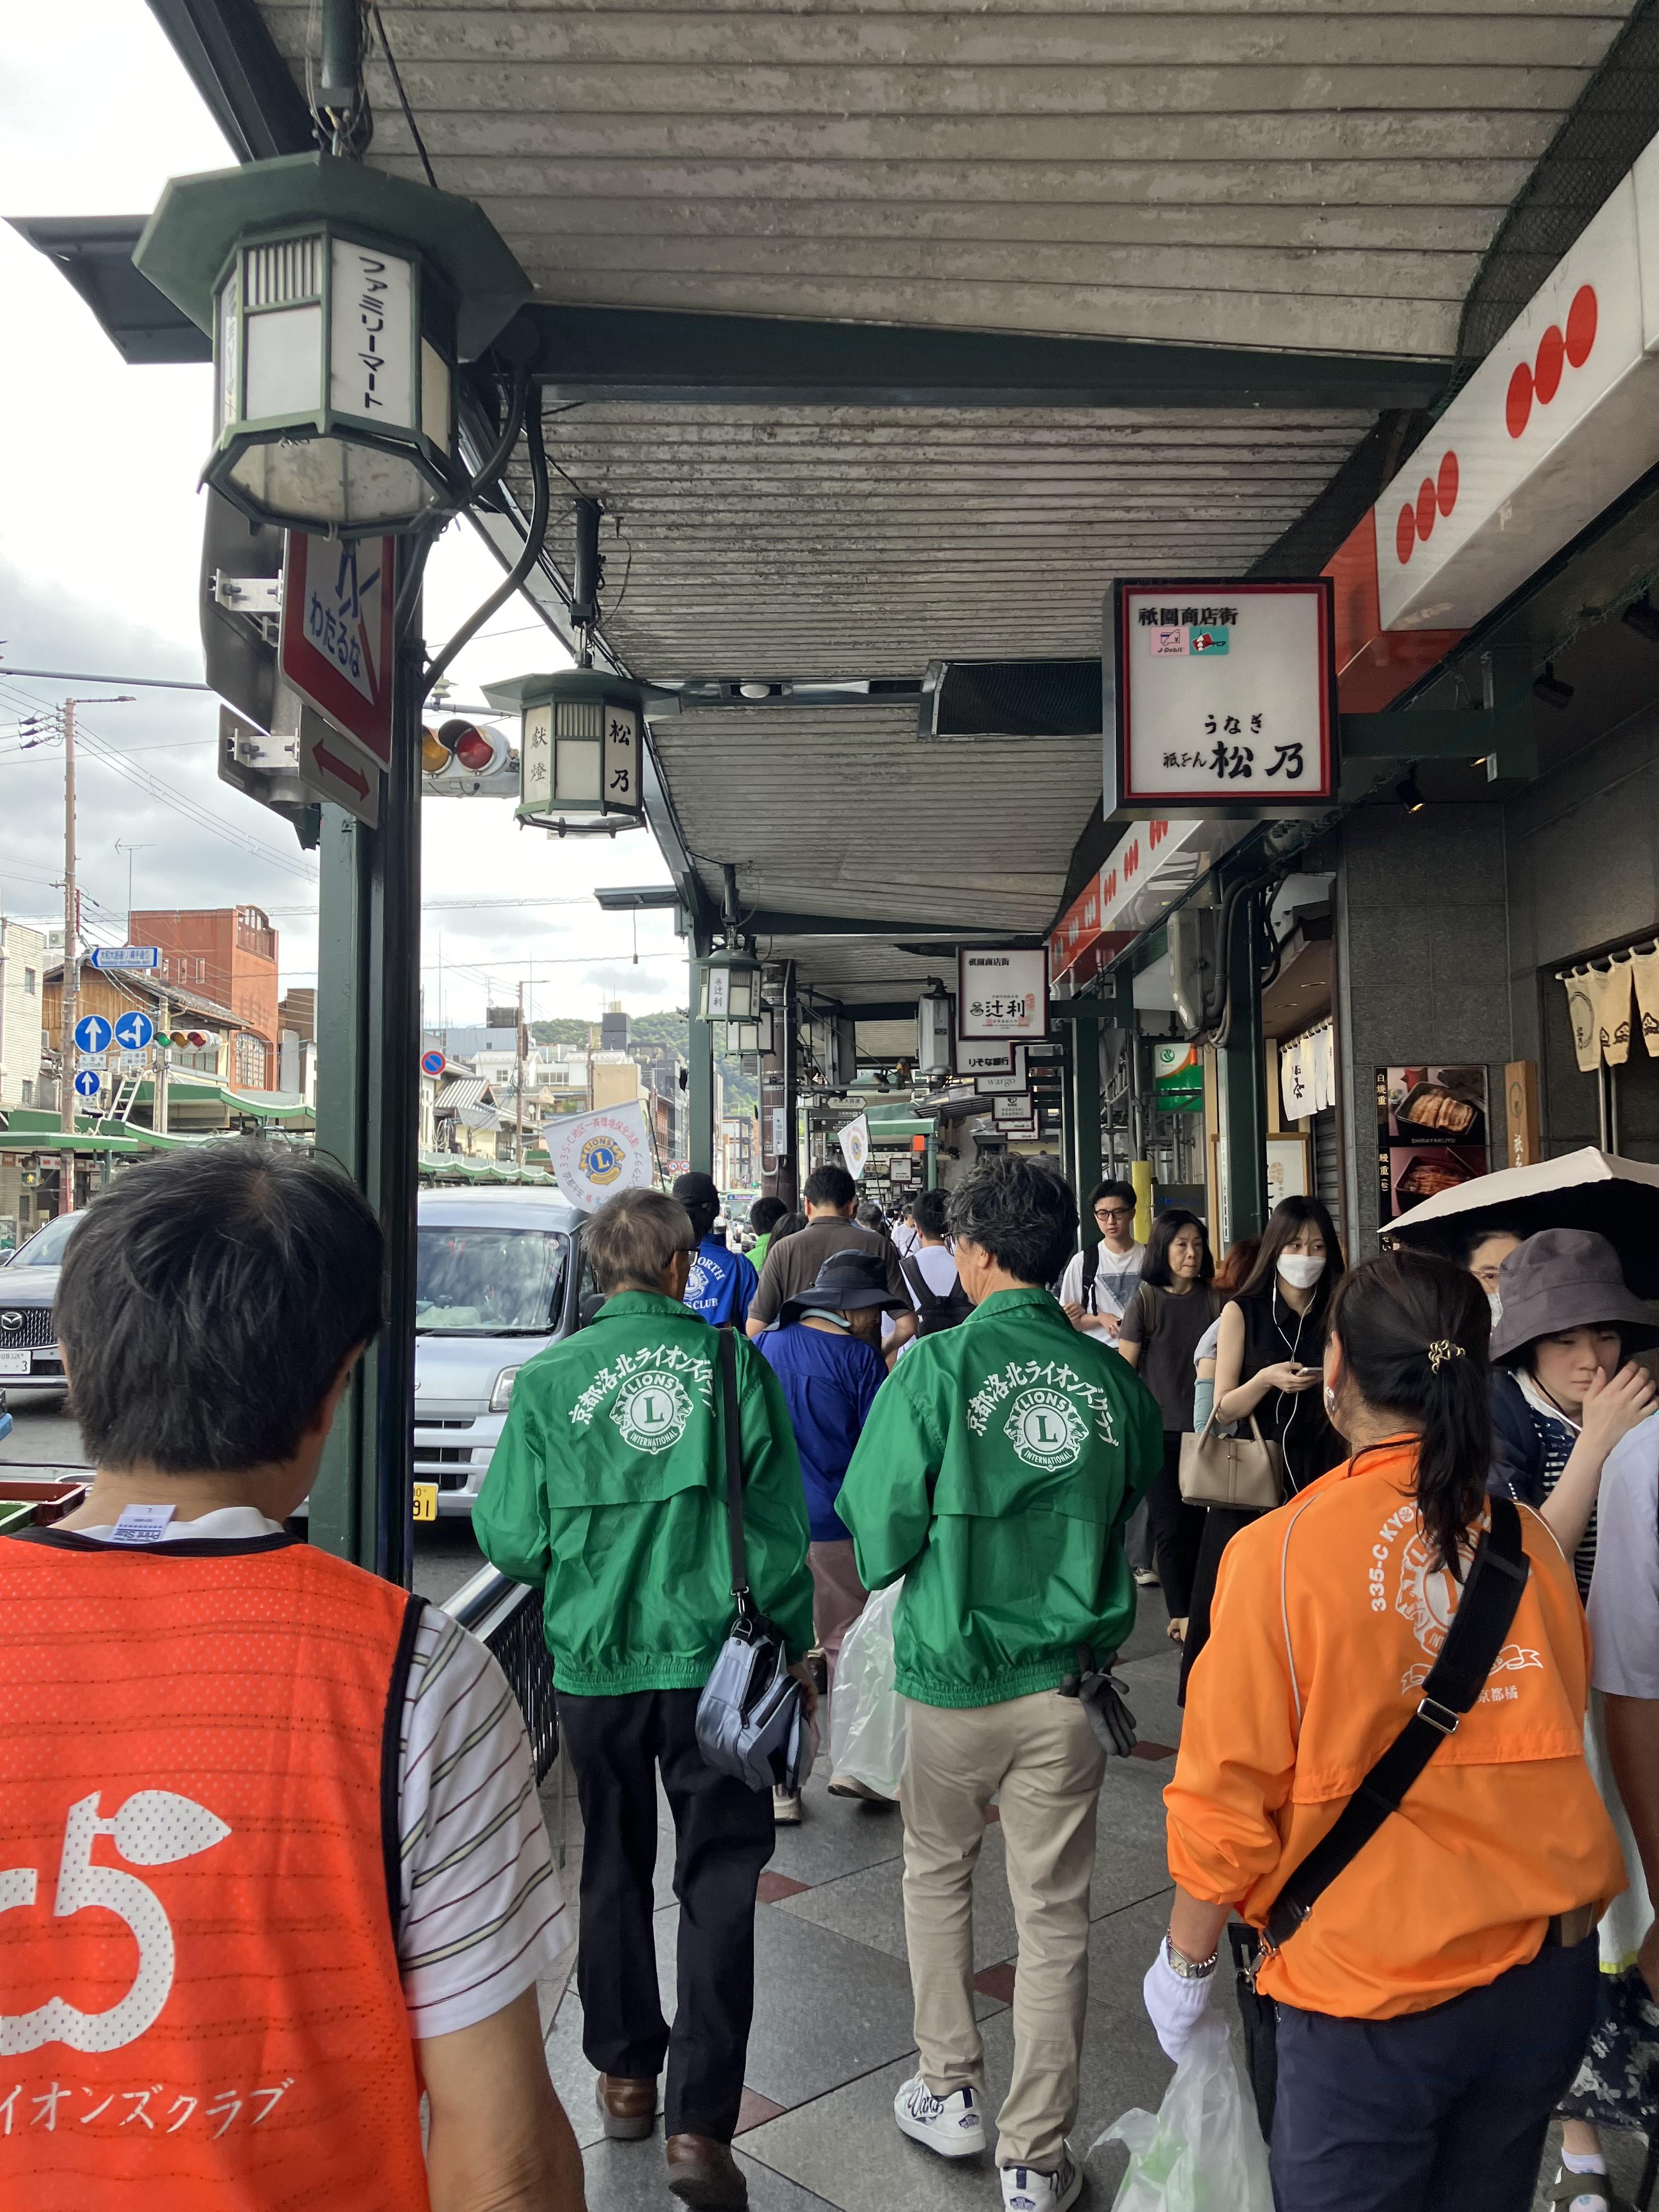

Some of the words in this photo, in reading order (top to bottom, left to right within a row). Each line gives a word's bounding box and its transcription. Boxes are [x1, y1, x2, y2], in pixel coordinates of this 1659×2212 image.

[358, 256, 387, 409] ファミリーマート
[309, 590, 362, 678] わたるな
[1204, 713, 1262, 734] うなぎ
[610, 719, 631, 793] 松乃
[1209, 741, 1304, 779] 松乃
[985, 1000, 1025, 1018] 辻利
[969, 1058, 1009, 1066] りそな銀行
[988, 1078, 1015, 1087] wargo
[1376, 1073, 1387, 1105] 白焼重
[584, 1138, 612, 1153] LIONS
[595, 1152, 610, 1169] L
[697, 1256, 725, 1281] ORTH
[693, 1297, 718, 1310] CLUB
[627, 1373, 676, 1394] LIONS
[966, 1360, 1119, 1437] 京都洛北ライオンズクラブ
[1019, 1391, 1067, 1410] LIONS
[643, 1396, 664, 1424] L
[630, 1429, 678, 1447] INTERNATIONAL
[1035, 1415, 1058, 1443] L
[1024, 1450, 1073, 1465] INTERNATIONAL
[1369, 1544, 1389, 1612] 335-C
